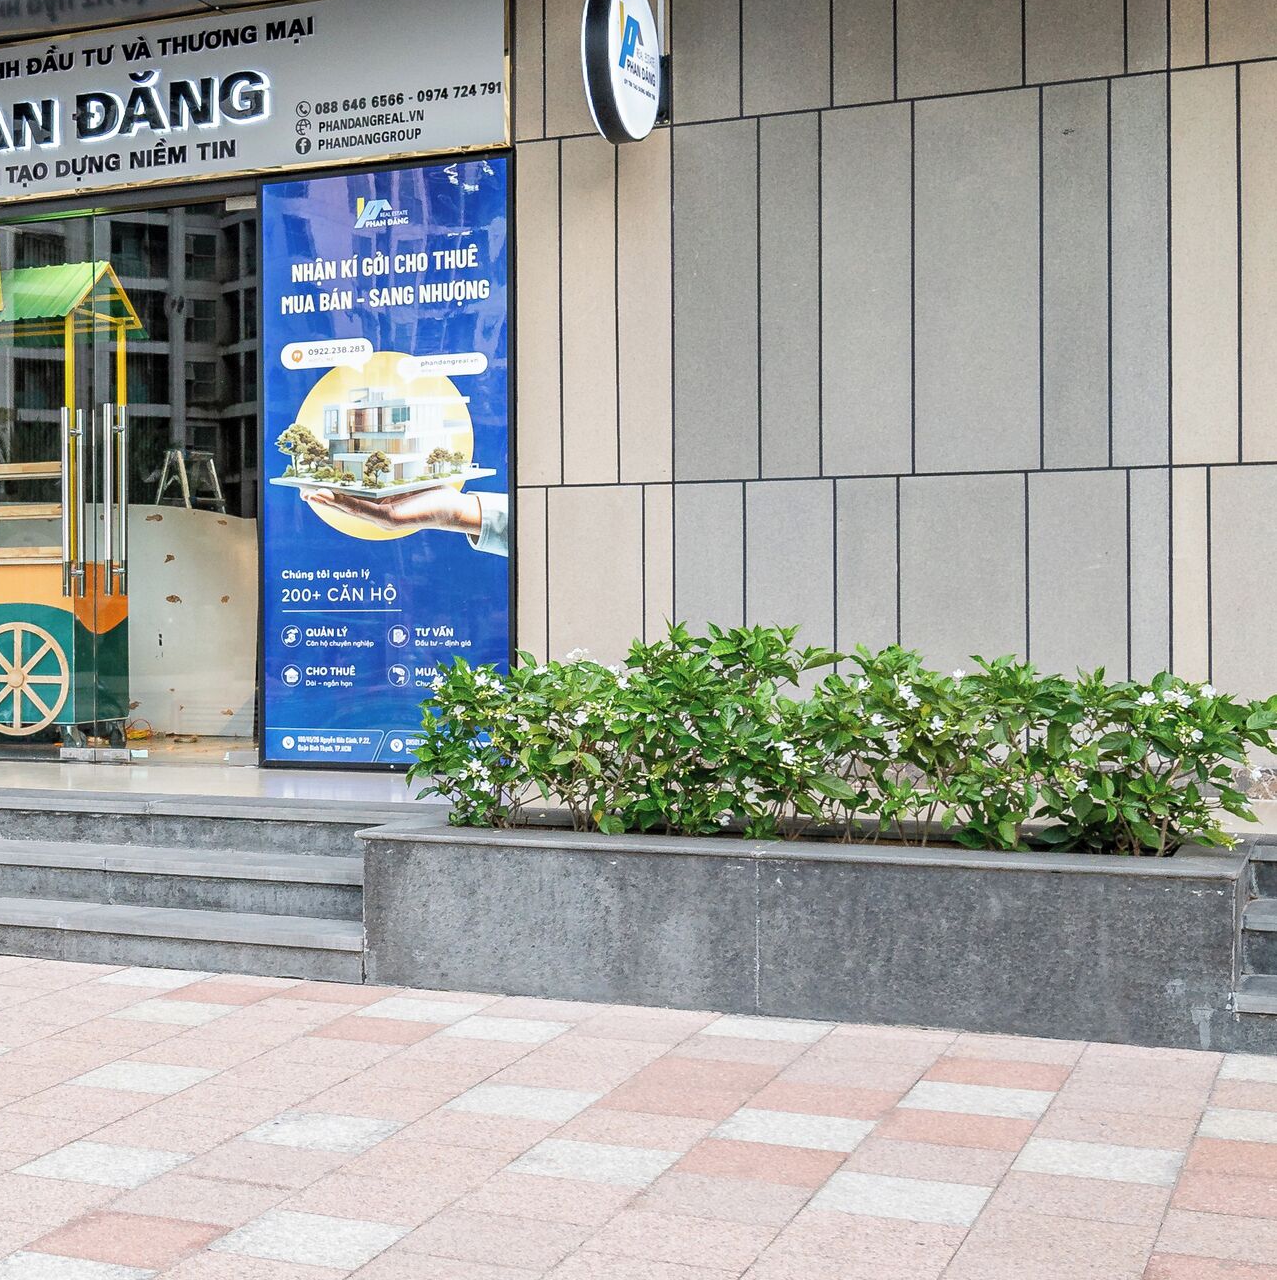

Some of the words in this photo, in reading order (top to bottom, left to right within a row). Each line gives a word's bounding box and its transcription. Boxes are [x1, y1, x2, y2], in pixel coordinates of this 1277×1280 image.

[26, 45, 74, 75] ĐẦU
[82, 45, 115, 67] TƯ
[123, 36, 152, 61] VÀ
[157, 25, 258, 56] THƯƠNG
[266, 16, 314, 44] MẠI
[72, 70, 270, 141] ĐĂNG
[315, 101, 338, 115] 088
[343, 98, 366, 111] 646
[371, 93, 404, 107] 6566
[417, 88, 448, 102] 0974
[453, 83, 477, 98] 724
[480, 81, 502, 95] 791
[318, 110, 424, 133] PHANDANGREAL.VN
[318, 128, 422, 150] PHANDANGGROUP
[6, 162, 48, 187] TẠO
[56, 153, 121, 181] DỰNG
[130, 138, 187, 169] NIỀM
[197, 140, 236, 160] TIN
[365, 220, 386, 228] PHAN
[387, 217, 408, 226] ĐĂNG
[291, 257, 337, 286] NHẬN
[340, 254, 358, 279] KÍ
[362, 251, 389, 276] GỞI
[394, 252, 428, 274] CHO
[433, 244, 478, 269] THUÊ
[281, 294, 315, 315] MUA
[319, 287, 352, 311] BÁN
[369, 285, 414, 308] SANG
[419, 278, 490, 307] NHƯỢNG
[308, 345, 365, 356] 0922.238.283
[281, 569, 313, 580] Chúng
[316, 569, 330, 579] tôi
[333, 569, 358, 580] quản
[361, 569, 370, 580] lý
[281, 589, 321, 603] 200+
[327, 584, 364, 602] CĂN
[370, 583, 397, 604] HỘ
[306, 626, 334, 638] QUẢN
[337, 625, 348, 637] LÝ
[415, 627, 430, 637] TƯ
[432, 625, 453, 637] VẤN
[320, 639, 328, 647] hộ
[329, 639, 351, 647] chuyên
[353, 639, 374, 647] nghiệp
[445, 639, 459, 647] định
[461, 639, 471, 647] giá
[306, 667, 327, 676] CHO
[330, 665, 355, 676] THUÊ
[323, 680, 339, 688] ngắn
[340, 680, 352, 688] hạn
